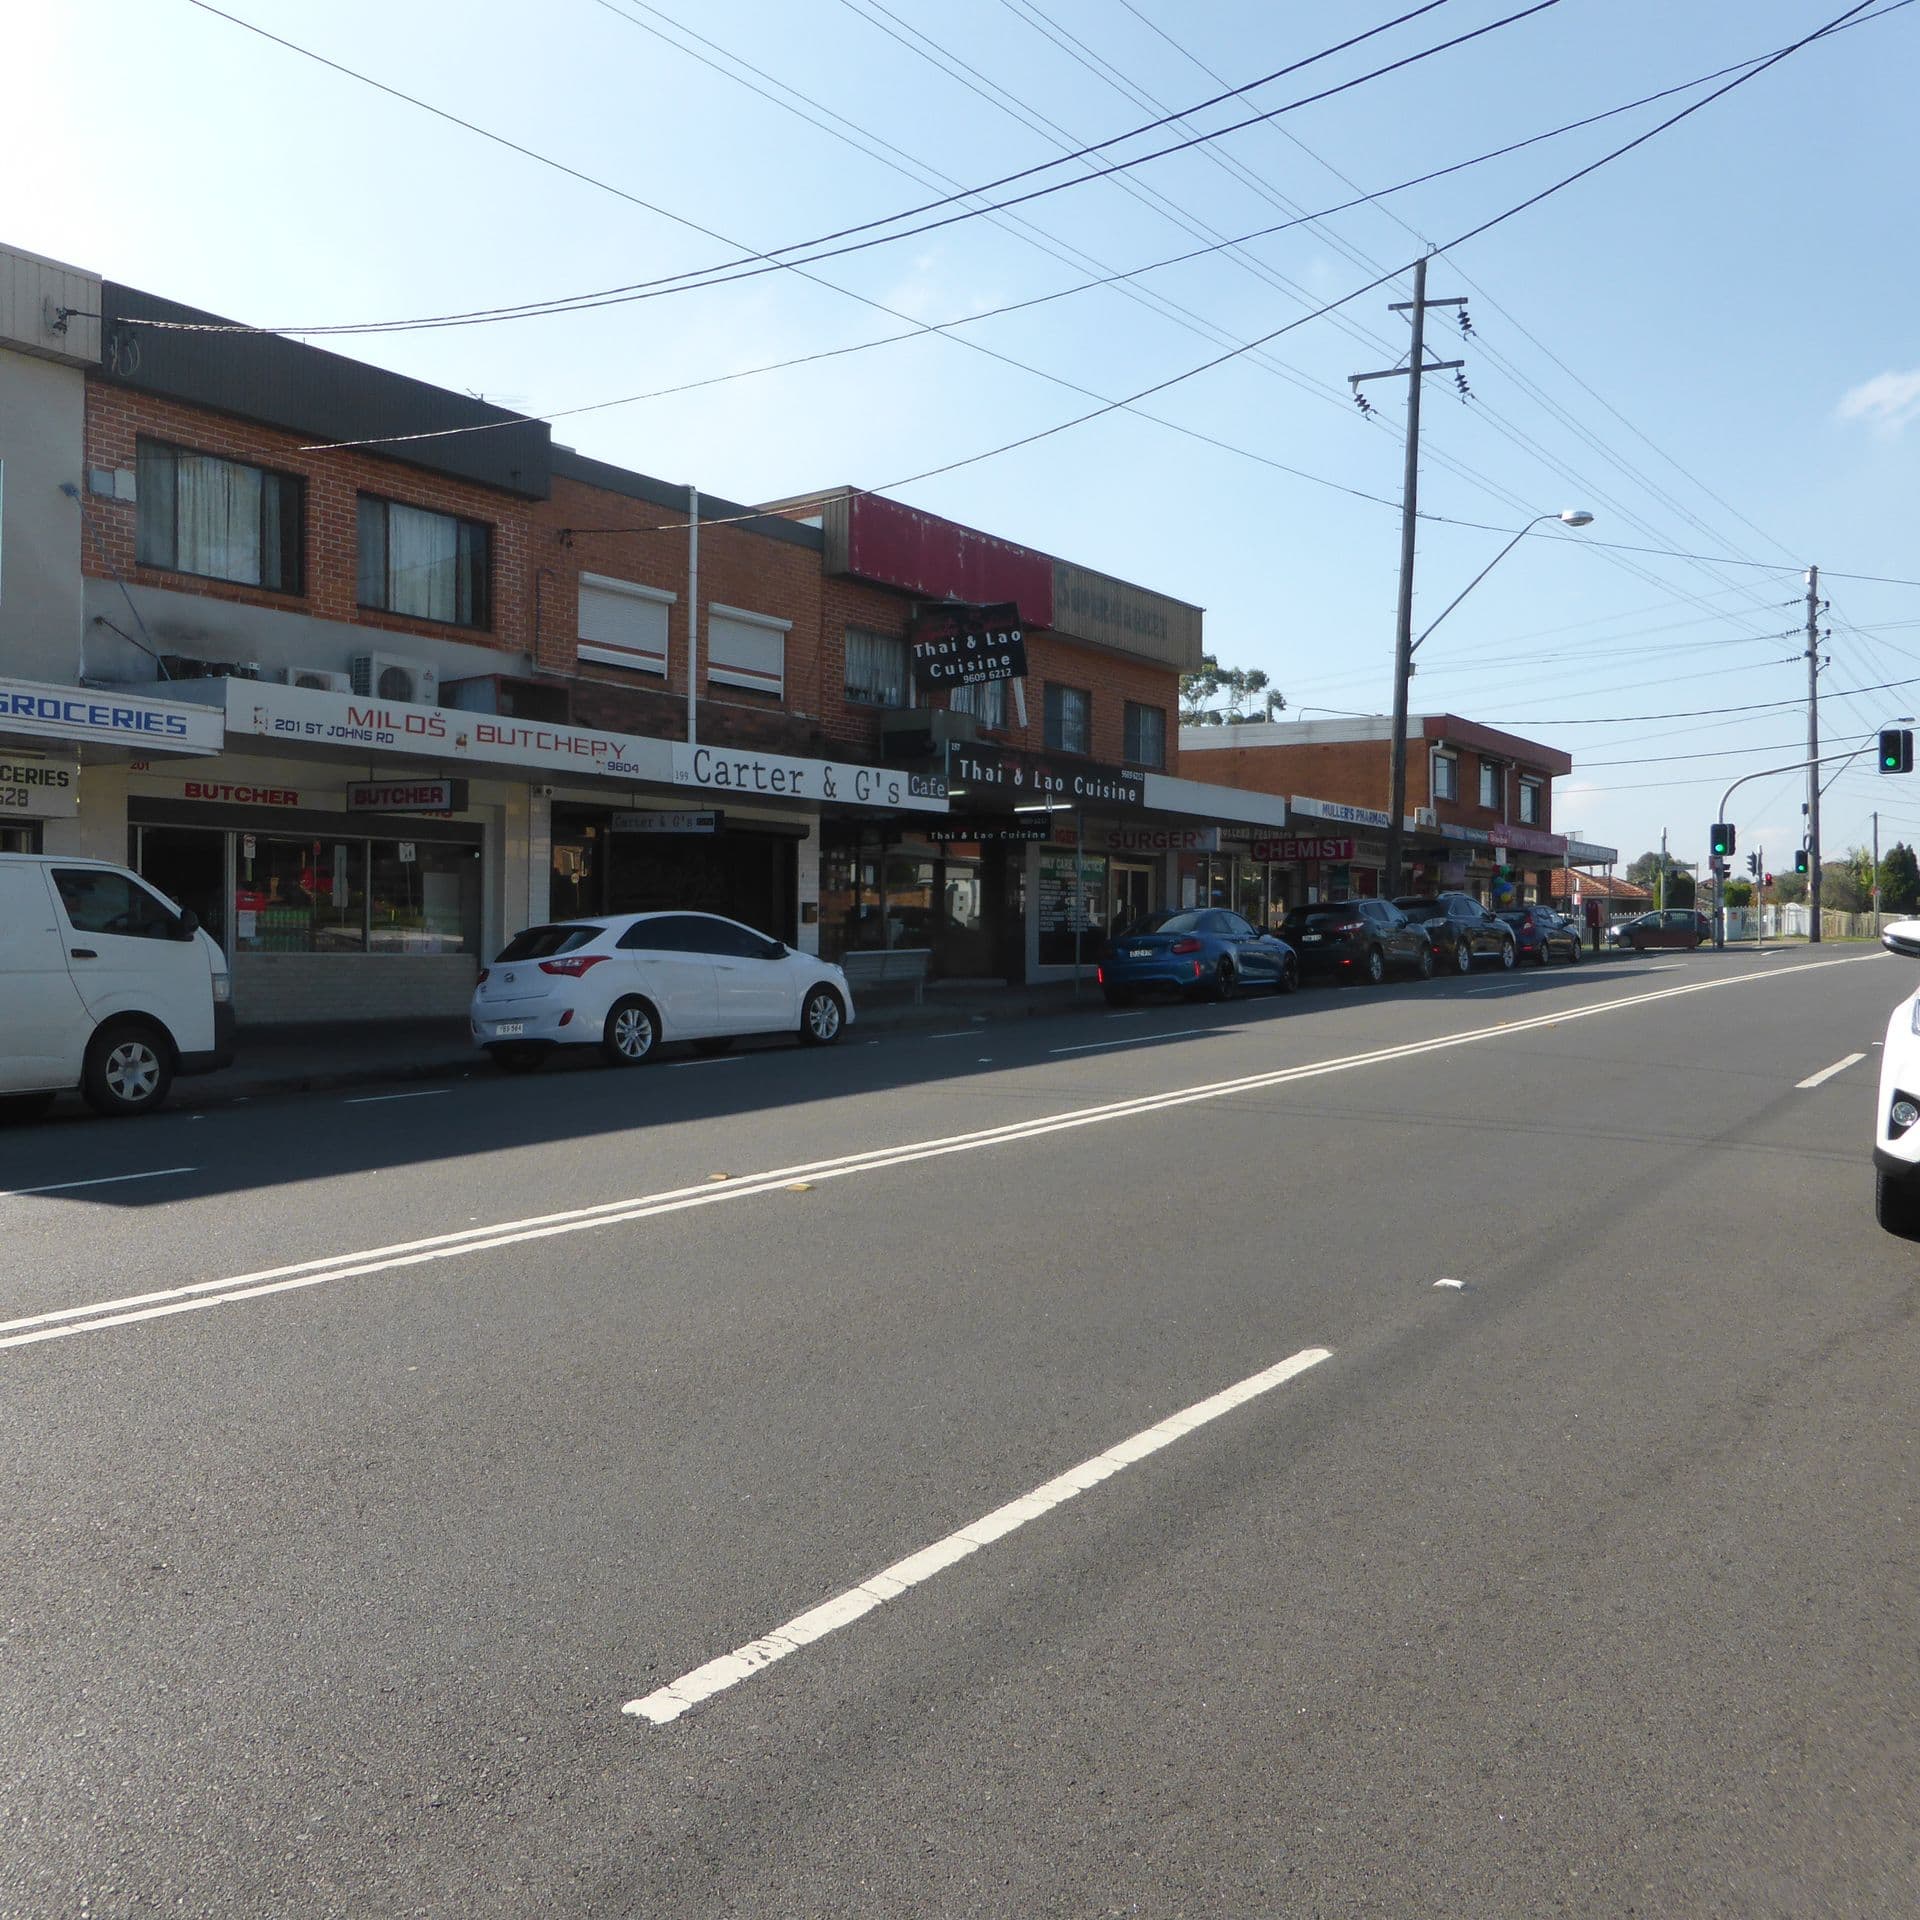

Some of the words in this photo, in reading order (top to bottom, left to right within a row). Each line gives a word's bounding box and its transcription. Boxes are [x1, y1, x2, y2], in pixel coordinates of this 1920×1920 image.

[913, 635, 957, 659] Thai
[965, 634, 977, 650] &
[985, 629, 1022, 647] Lao
[929, 653, 1011, 678] Cuisine
[962, 671, 987, 684] 9609
[988, 667, 1013, 681] 6212
[274, 718, 300, 732] 201
[304, 722, 323, 735] ST
[326, 725, 373, 741] JOHNS
[375, 731, 394, 744] RD
[347, 706, 447, 738] MILOŠ
[607, 760, 640, 774] 9604
[693, 748, 804, 796] Carter
[822, 765, 838, 799] &
[855, 769, 900, 805] G's
[911, 775, 946, 798] Cafe
[959, 758, 1004, 784] Thai
[1013, 766, 1024, 786] &
[1033, 770, 1064, 792] Lao
[1073, 775, 1137, 802] Cuisine
[184, 781, 299, 806] BUTCHER
[354, 786, 444, 806] BUTCHER
[930, 831, 955, 840] Thai
[973, 831, 994, 840] Lao
[1000, 831, 1047, 840] Cuisine
[1108, 830, 1207, 849] SURGERY
[1254, 838, 1350, 860] CHEMIST
